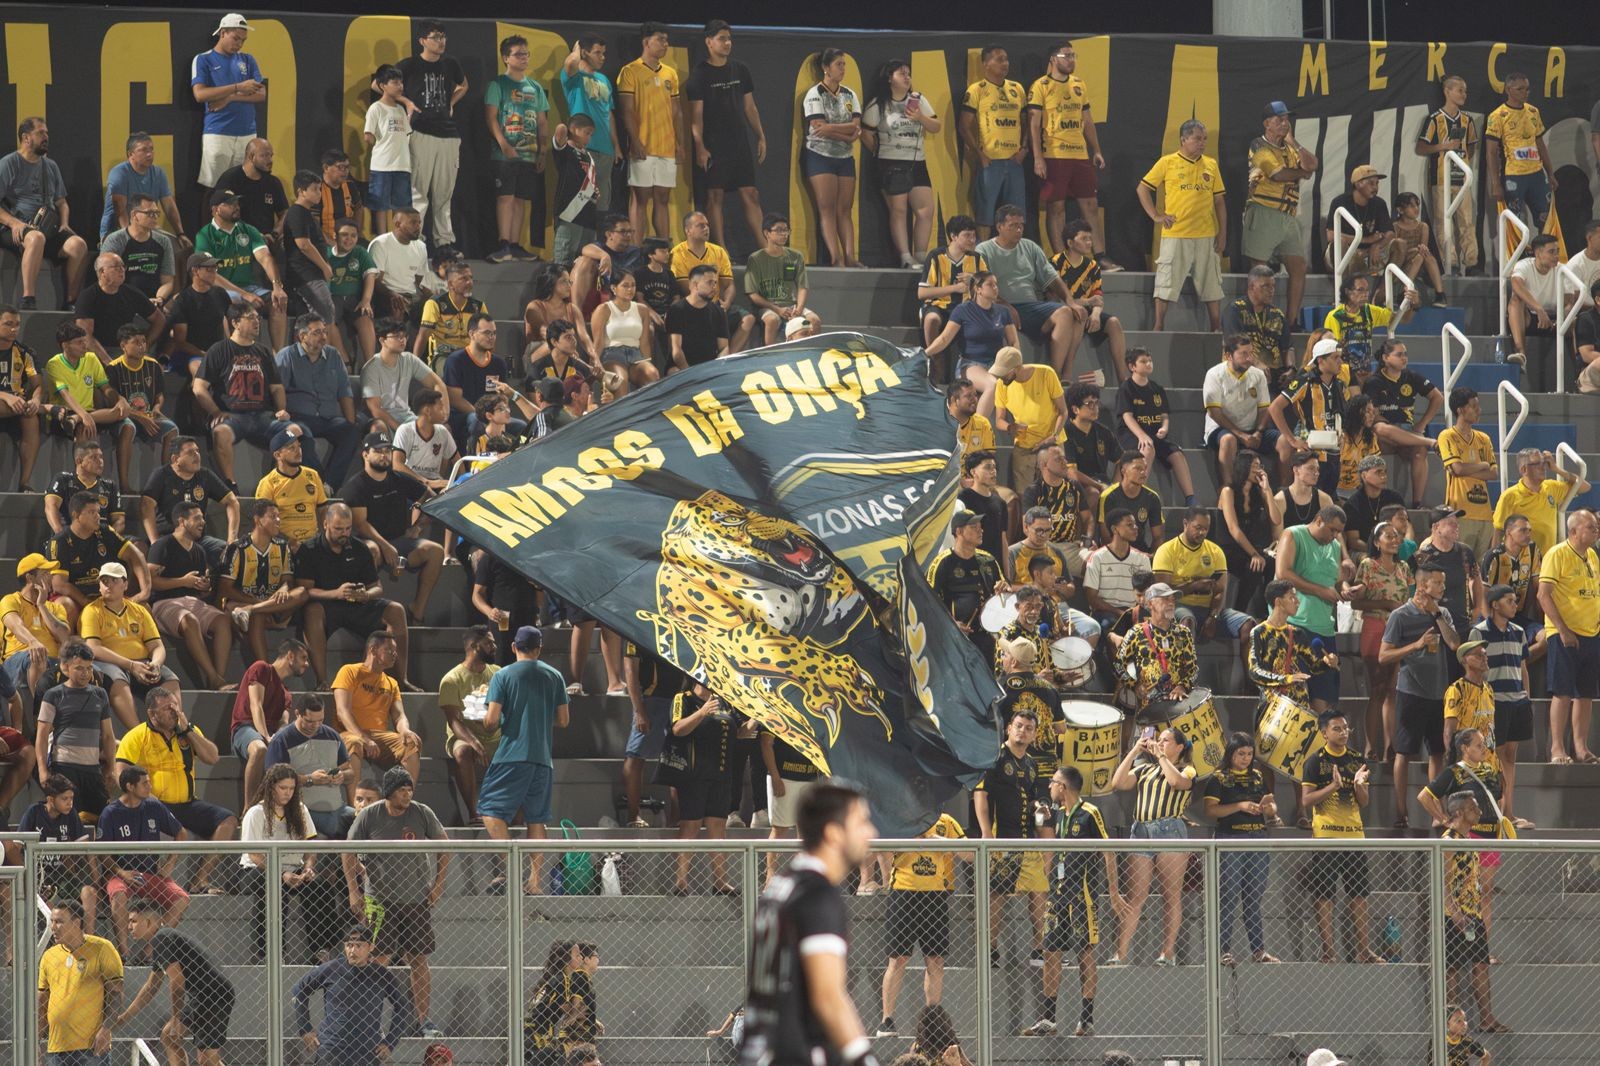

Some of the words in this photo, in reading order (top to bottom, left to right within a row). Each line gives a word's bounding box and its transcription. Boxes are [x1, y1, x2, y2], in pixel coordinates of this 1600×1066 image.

[662, 389, 744, 457] DA
[741, 348, 902, 426] ONÇA
[797, 494, 905, 541] ZONAS
[119, 825, 131, 838] 18
